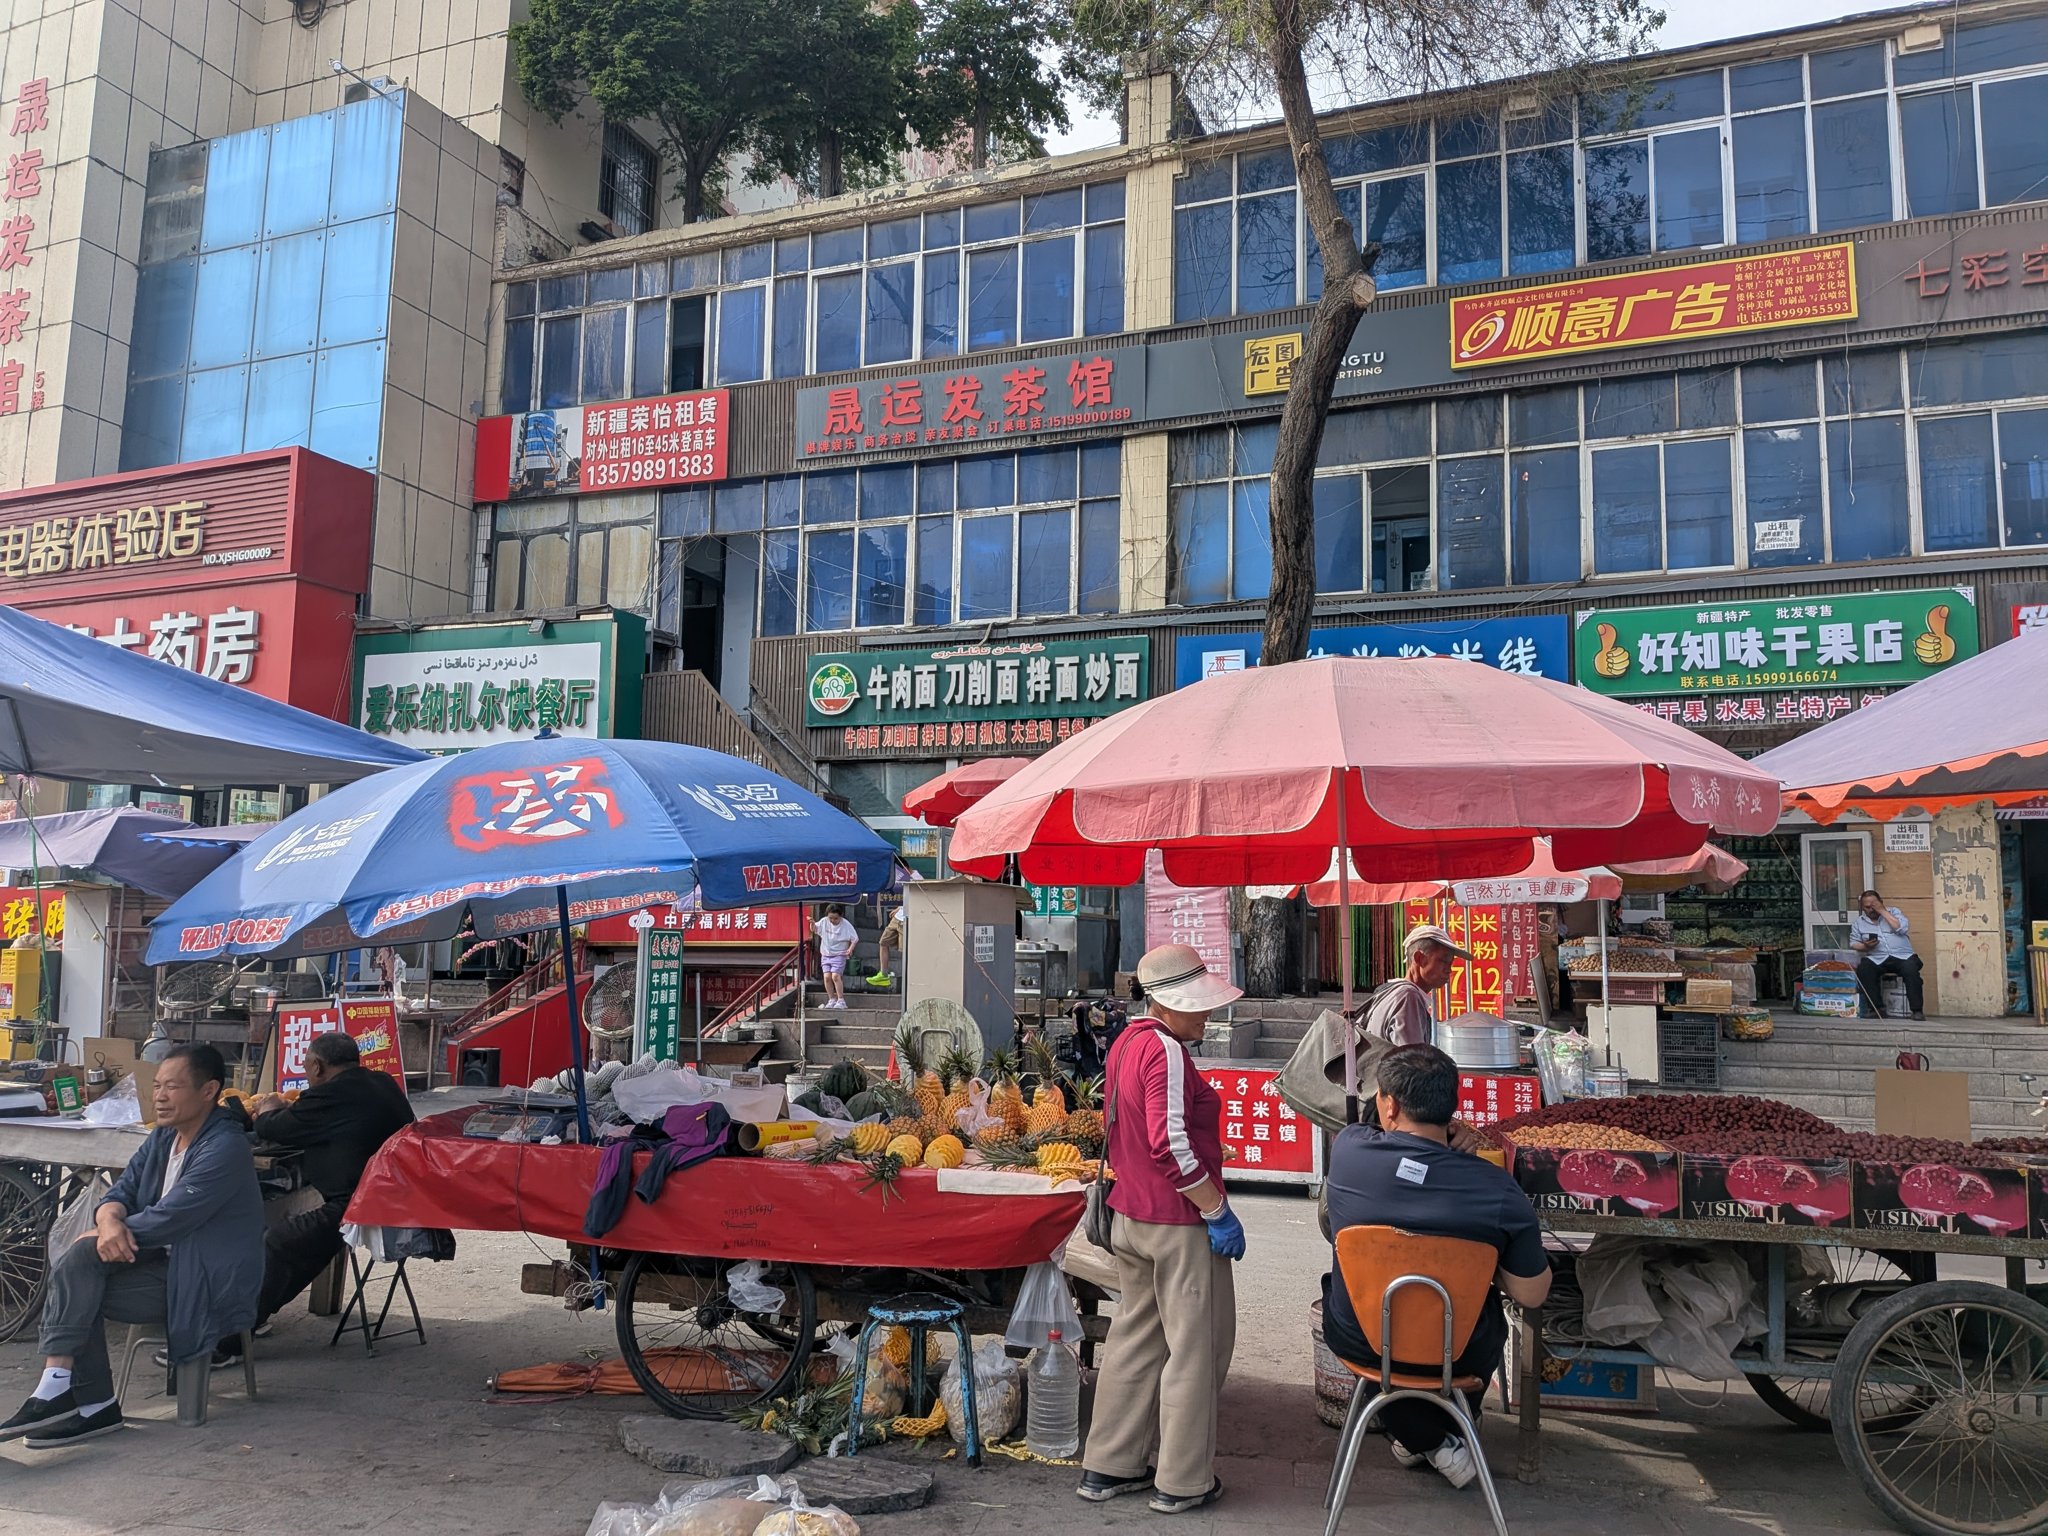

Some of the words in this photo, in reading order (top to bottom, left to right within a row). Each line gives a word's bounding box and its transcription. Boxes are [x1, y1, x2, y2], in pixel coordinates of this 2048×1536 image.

[1766, 266, 1794, 277] 金属字
[1796, 259, 1846, 273] LED发光字
[1784, 285, 1804, 296] 路牌
[1818, 279, 1846, 291] 文化墙
[1504, 282, 1731, 351] 顺意广告
[1250, 341, 1295, 367] 宏图
[1250, 366, 1292, 389] 广告
[822, 356, 1114, 437] 晟运发茶馆
[586, 396, 718, 437] 新疆荣怡租赁
[585, 426, 716, 461] 对外出租16至45米登高车
[925, 423, 978, 442] 亲友聚会
[587, 453, 714, 486] 13579891383
[1767, 521, 1788, 531] 出租
[0, 500, 207, 578] 电器体验店
[202, 547, 272, 565] NO.XJSHG00009
[1696, 610, 1751, 624] 新疆特产
[1775, 604, 1834, 619] 批发零售
[1638, 619, 1904, 675] 好知味干果店
[364, 679, 595, 734] 爱乐纳扎尔快餐厅
[1715, 698, 1765, 722] 水果
[1775, 695, 1851, 720] 土特产
[844, 726, 880, 750] 牛肉面
[881, 724, 919, 748] 刀削面
[922, 723, 948, 747] 拌面
[950, 722, 977, 746] 炒面
[980, 720, 1007, 745] 抓饭
[1011, 718, 1053, 744] 大盘鸡
[1897, 824, 1919, 833] 出租
[743, 865, 791, 893] WAR
[793, 861, 858, 888] HORSE
[1464, 880, 1576, 901] 自然光·更健康
[664, 912, 768, 931] 中国福利彩票
[180, 926, 227, 951] WAR
[651, 972, 678, 988] 牛肉面
[650, 989, 677, 1005] 刀削面
[649, 1006, 676, 1023] 拌面
[648, 1024, 675, 1041] 炒面
[1514, 1082, 1533, 1093] 3元
[1514, 1093, 1533, 1104] 2元
[1226, 1100, 1297, 1120] 玉米馍
[1514, 1104, 1533, 1113] 3元
[1226, 1121, 1297, 1143] 红豆馍
[1524, 1193, 1616, 1217] TUNISIA
[1691, 1201, 1786, 1225] TUNISIA
[1863, 1208, 1961, 1235] TUNISIA
